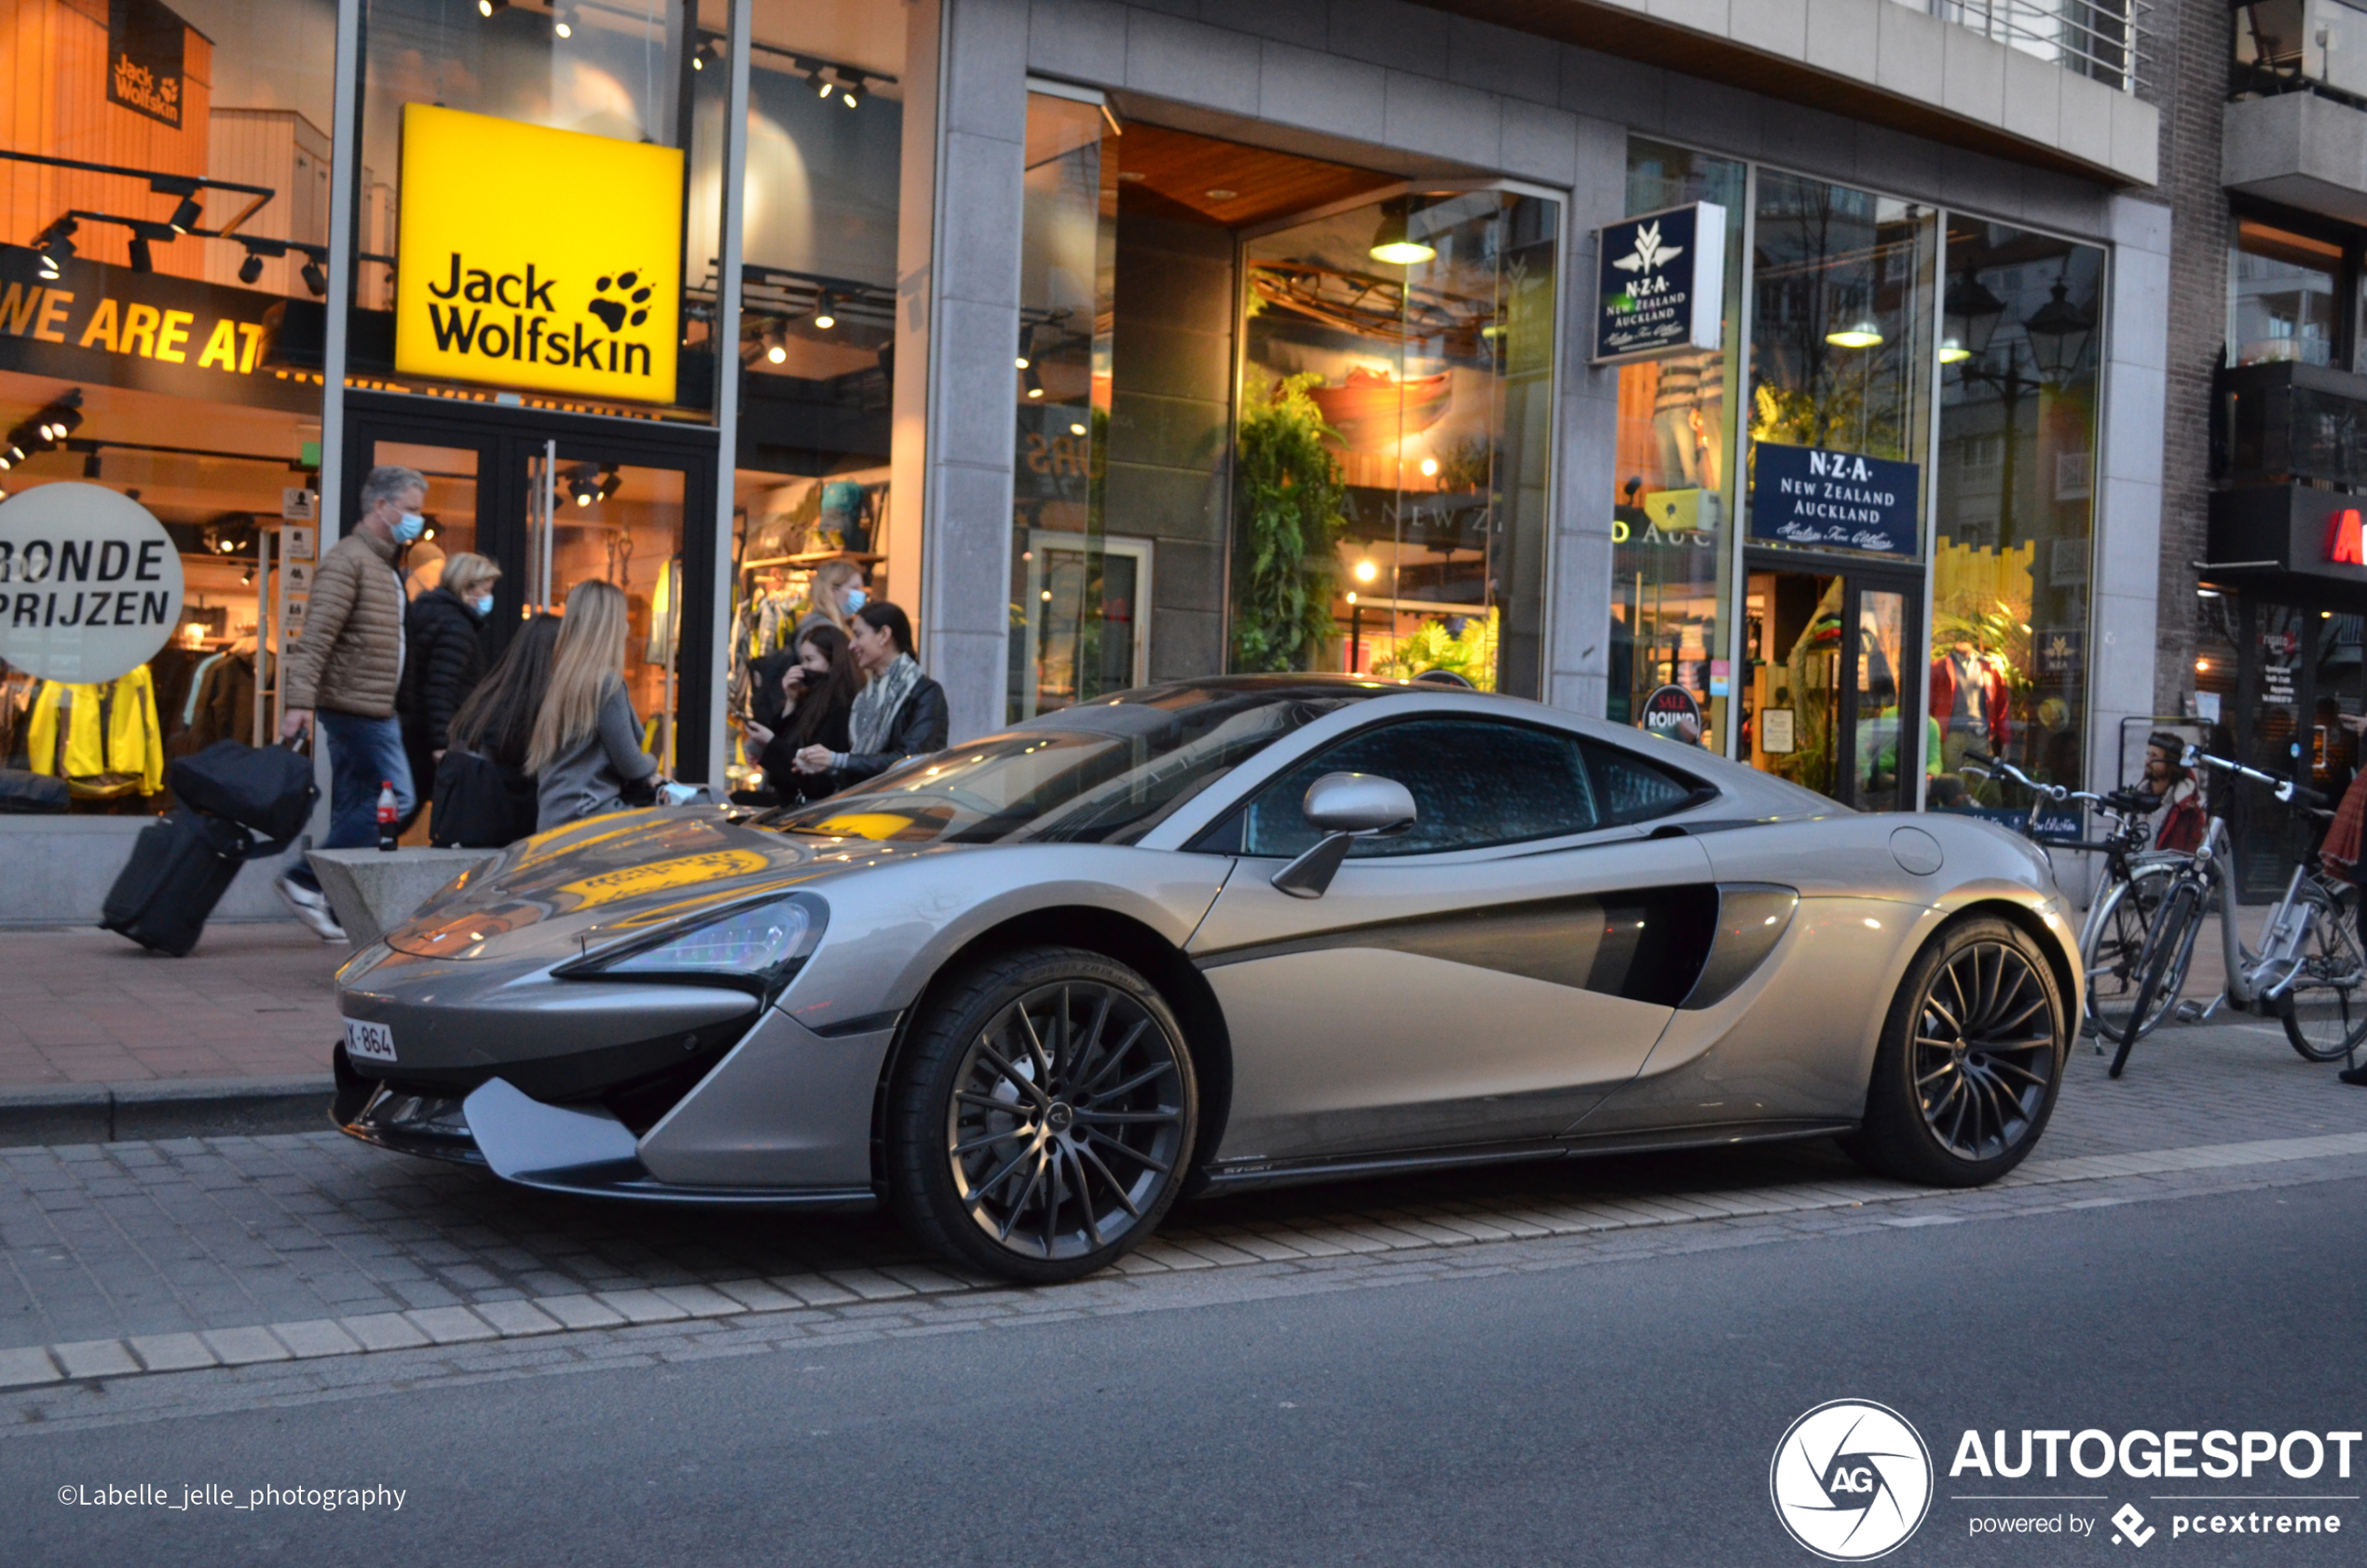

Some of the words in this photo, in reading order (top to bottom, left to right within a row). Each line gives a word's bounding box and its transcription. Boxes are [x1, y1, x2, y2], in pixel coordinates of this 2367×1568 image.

[115, 52, 154, 90] Jack
[115, 72, 178, 122] Wolfskin
[427, 252, 559, 312] Jack
[1615, 307, 1676, 328] AUCKLAND
[1635, 292, 1686, 312] ZEALAND
[0, 281, 75, 343] WE
[79, 297, 194, 363] ARE
[198, 318, 262, 373] AT
[427, 302, 651, 376] Wolfskin
[1781, 477, 1816, 497] NEW
[1824, 482, 1895, 507] ZEALAND
[1794, 499, 1881, 525] AUCKLAND
[2333, 509, 2367, 566] A
[1658, 694, 1687, 709] SALE
[345, 1023, 392, 1057] X-864
